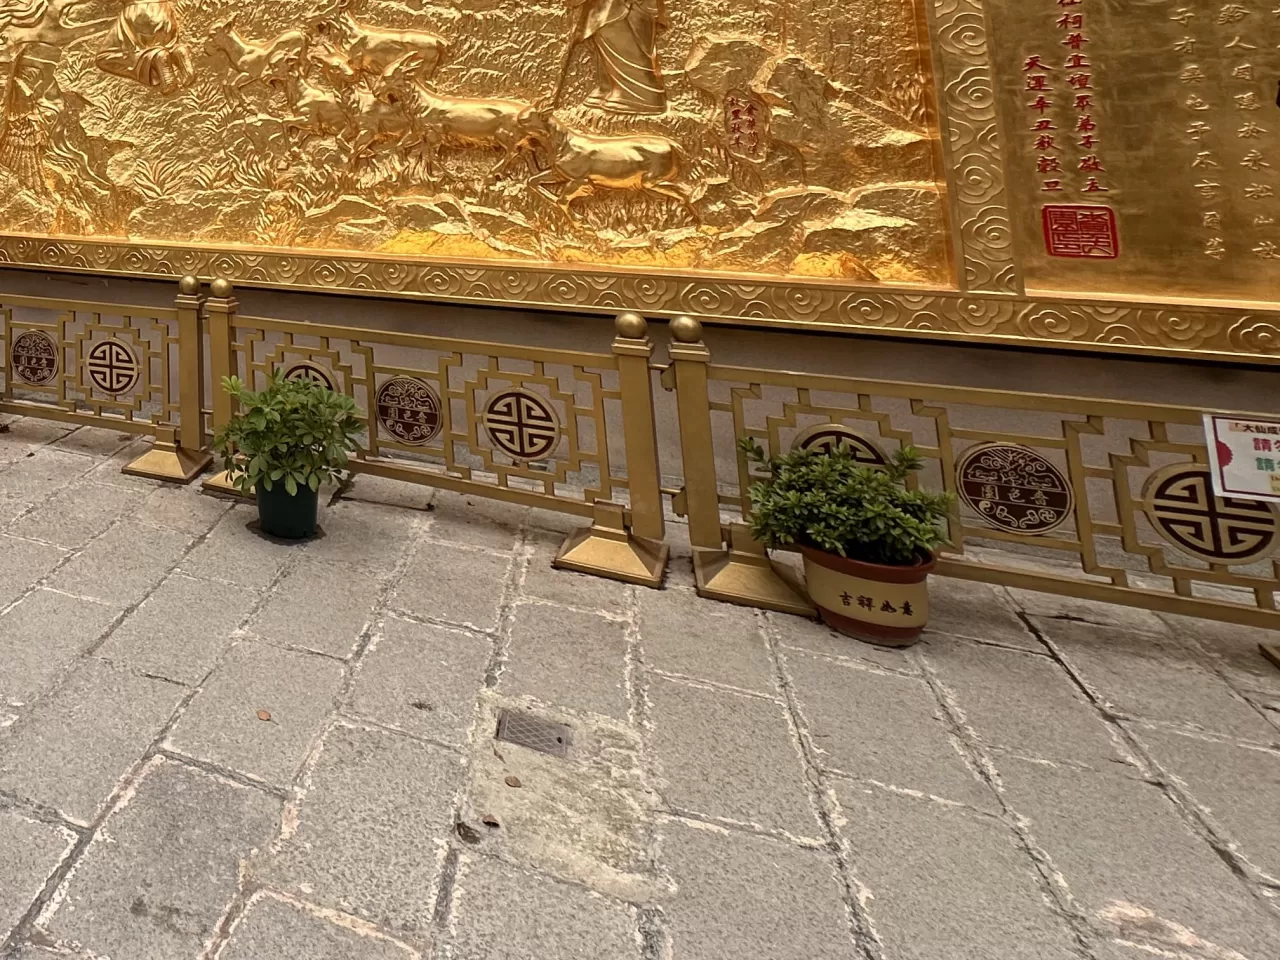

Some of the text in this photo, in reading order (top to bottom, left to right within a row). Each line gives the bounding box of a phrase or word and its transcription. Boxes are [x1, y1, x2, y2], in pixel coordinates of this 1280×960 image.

[1234, 422, 1280, 435] 「大仙成
[838, 590, 914, 617] 吉祥如意
